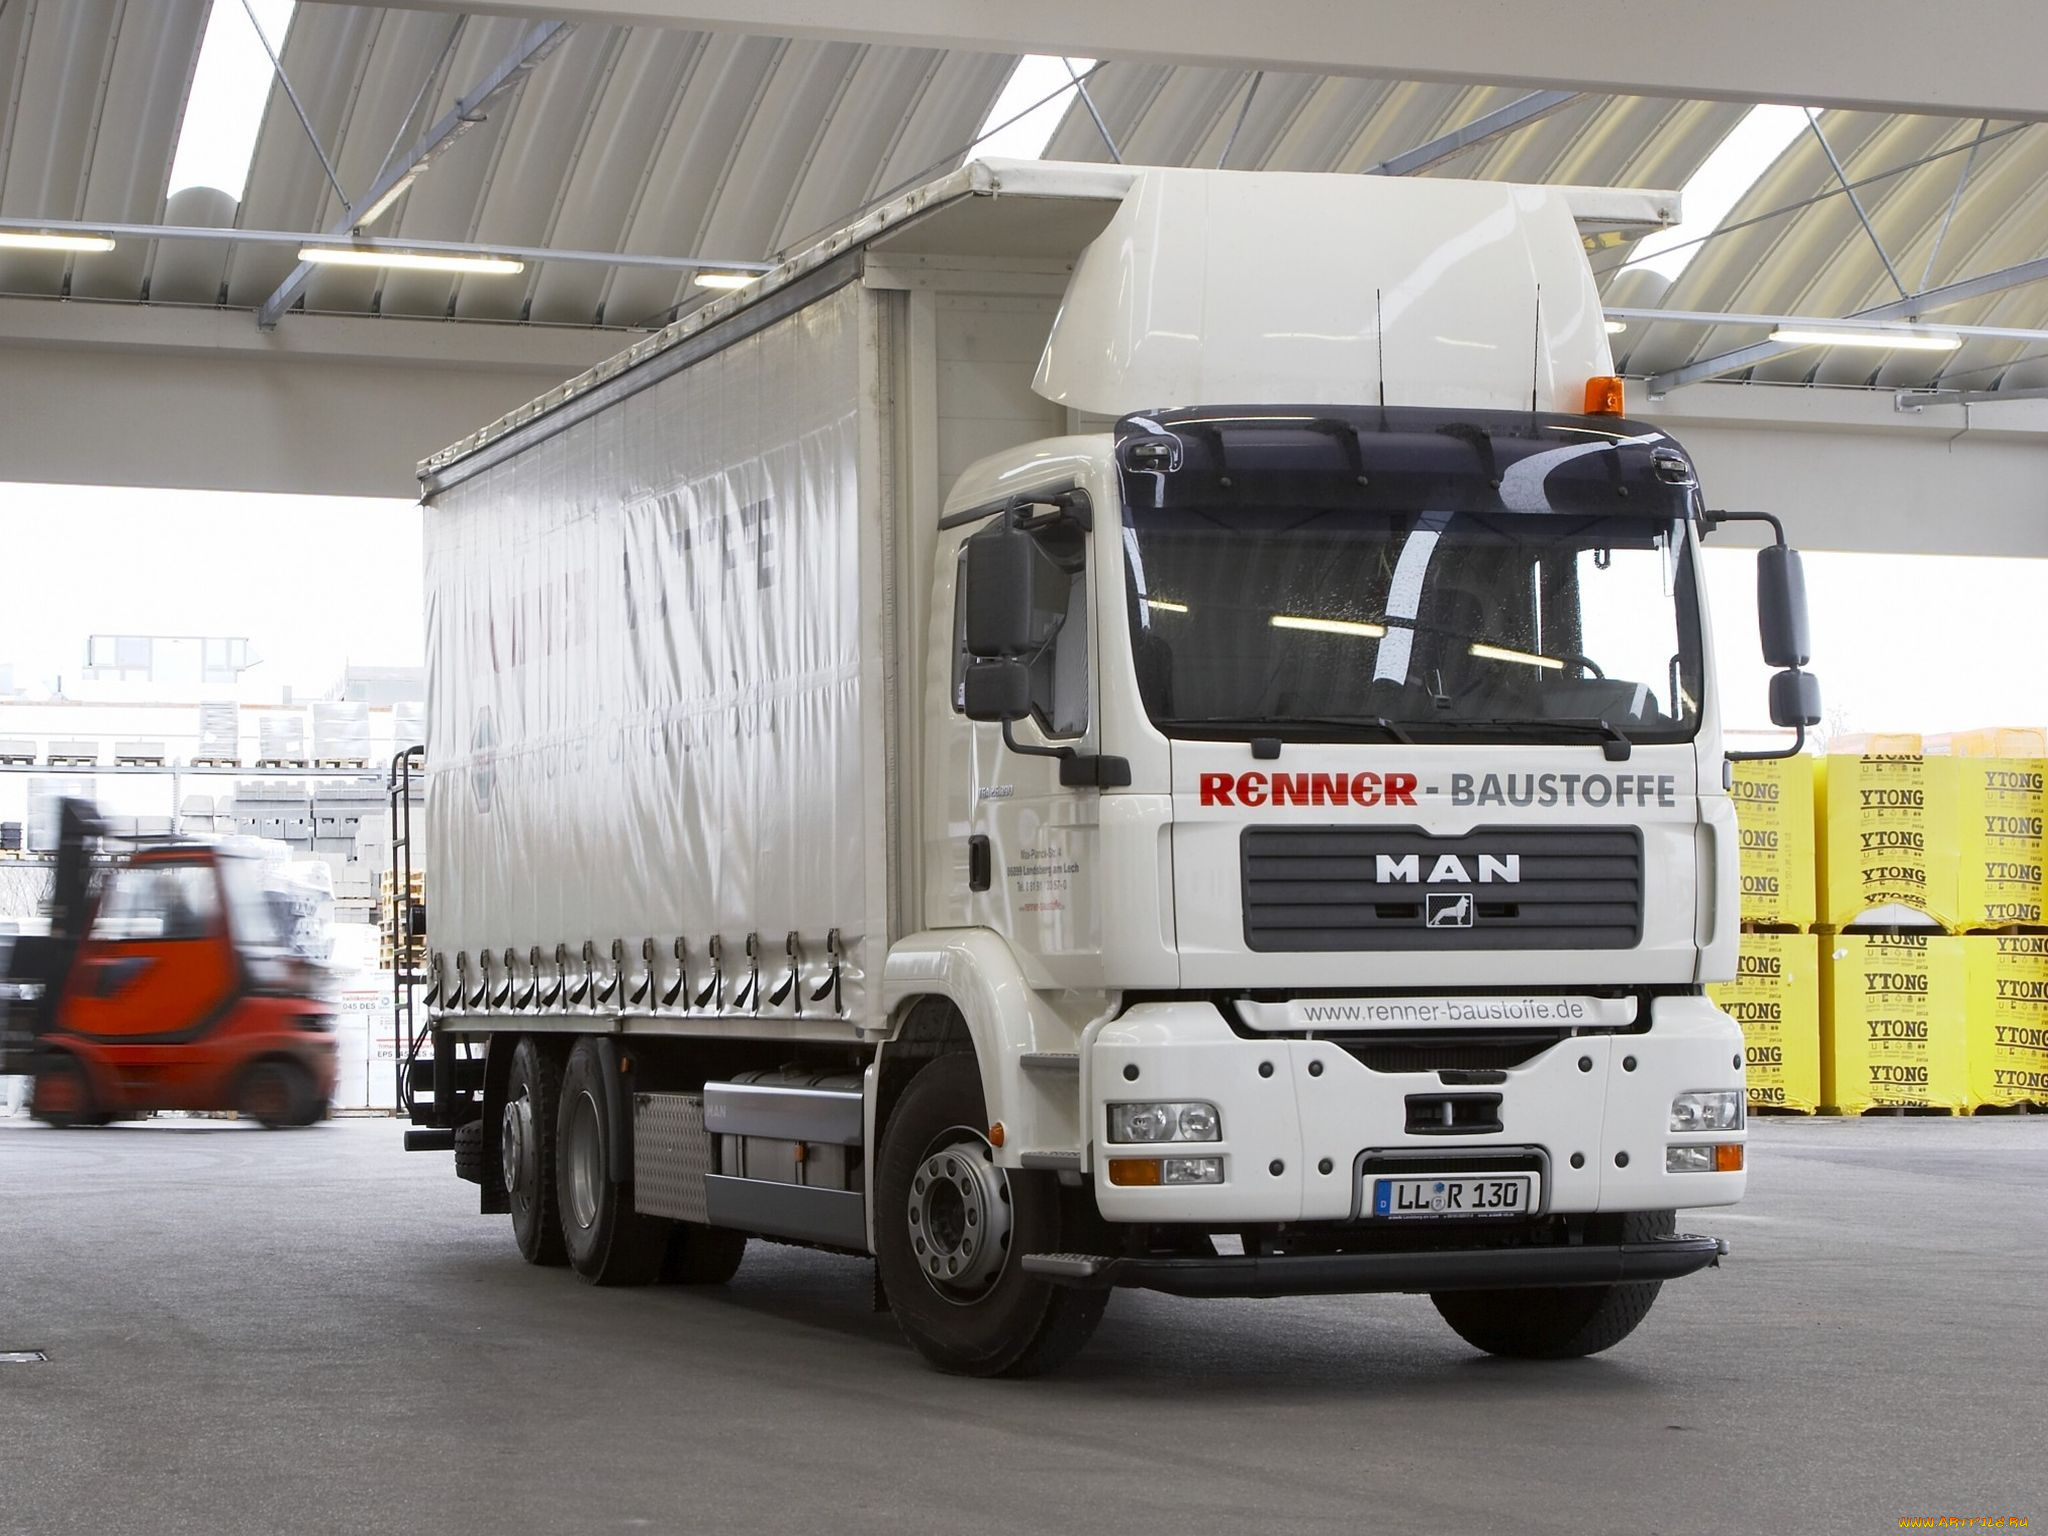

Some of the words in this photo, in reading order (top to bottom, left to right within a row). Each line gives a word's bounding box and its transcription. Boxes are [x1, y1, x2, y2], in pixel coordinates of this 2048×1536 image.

[1985, 771, 2043, 789] YTONG
[1200, 772, 1418, 807] RENNER
[1451, 773, 1675, 807] BAUSTOFFE
[1732, 781, 1779, 800] TONG
[1860, 789, 1924, 806] YTONG
[1984, 815, 2043, 835] YTONG
[1739, 829, 1778, 847] ONG
[1860, 831, 1924, 848] YTONG
[1376, 855, 1520, 883] MAN
[1862, 866, 1926, 882] YTONG
[1985, 862, 2042, 881] YTONG
[1741, 876, 1779, 893] ONG
[1984, 903, 2041, 921] YTONG
[1737, 956, 1781, 974] TONG
[1864, 973, 1928, 990] YTONG
[1304, 1000, 1584, 1022] www.renner-baustoffe.de
[1867, 1020, 1928, 1038] YTONG
[1745, 1047, 1782, 1063] ONG
[1869, 1065, 1928, 1082] YTONG
[1747, 1088, 1785, 1100] ONG
[1472, 1183, 1518, 1208] 130
